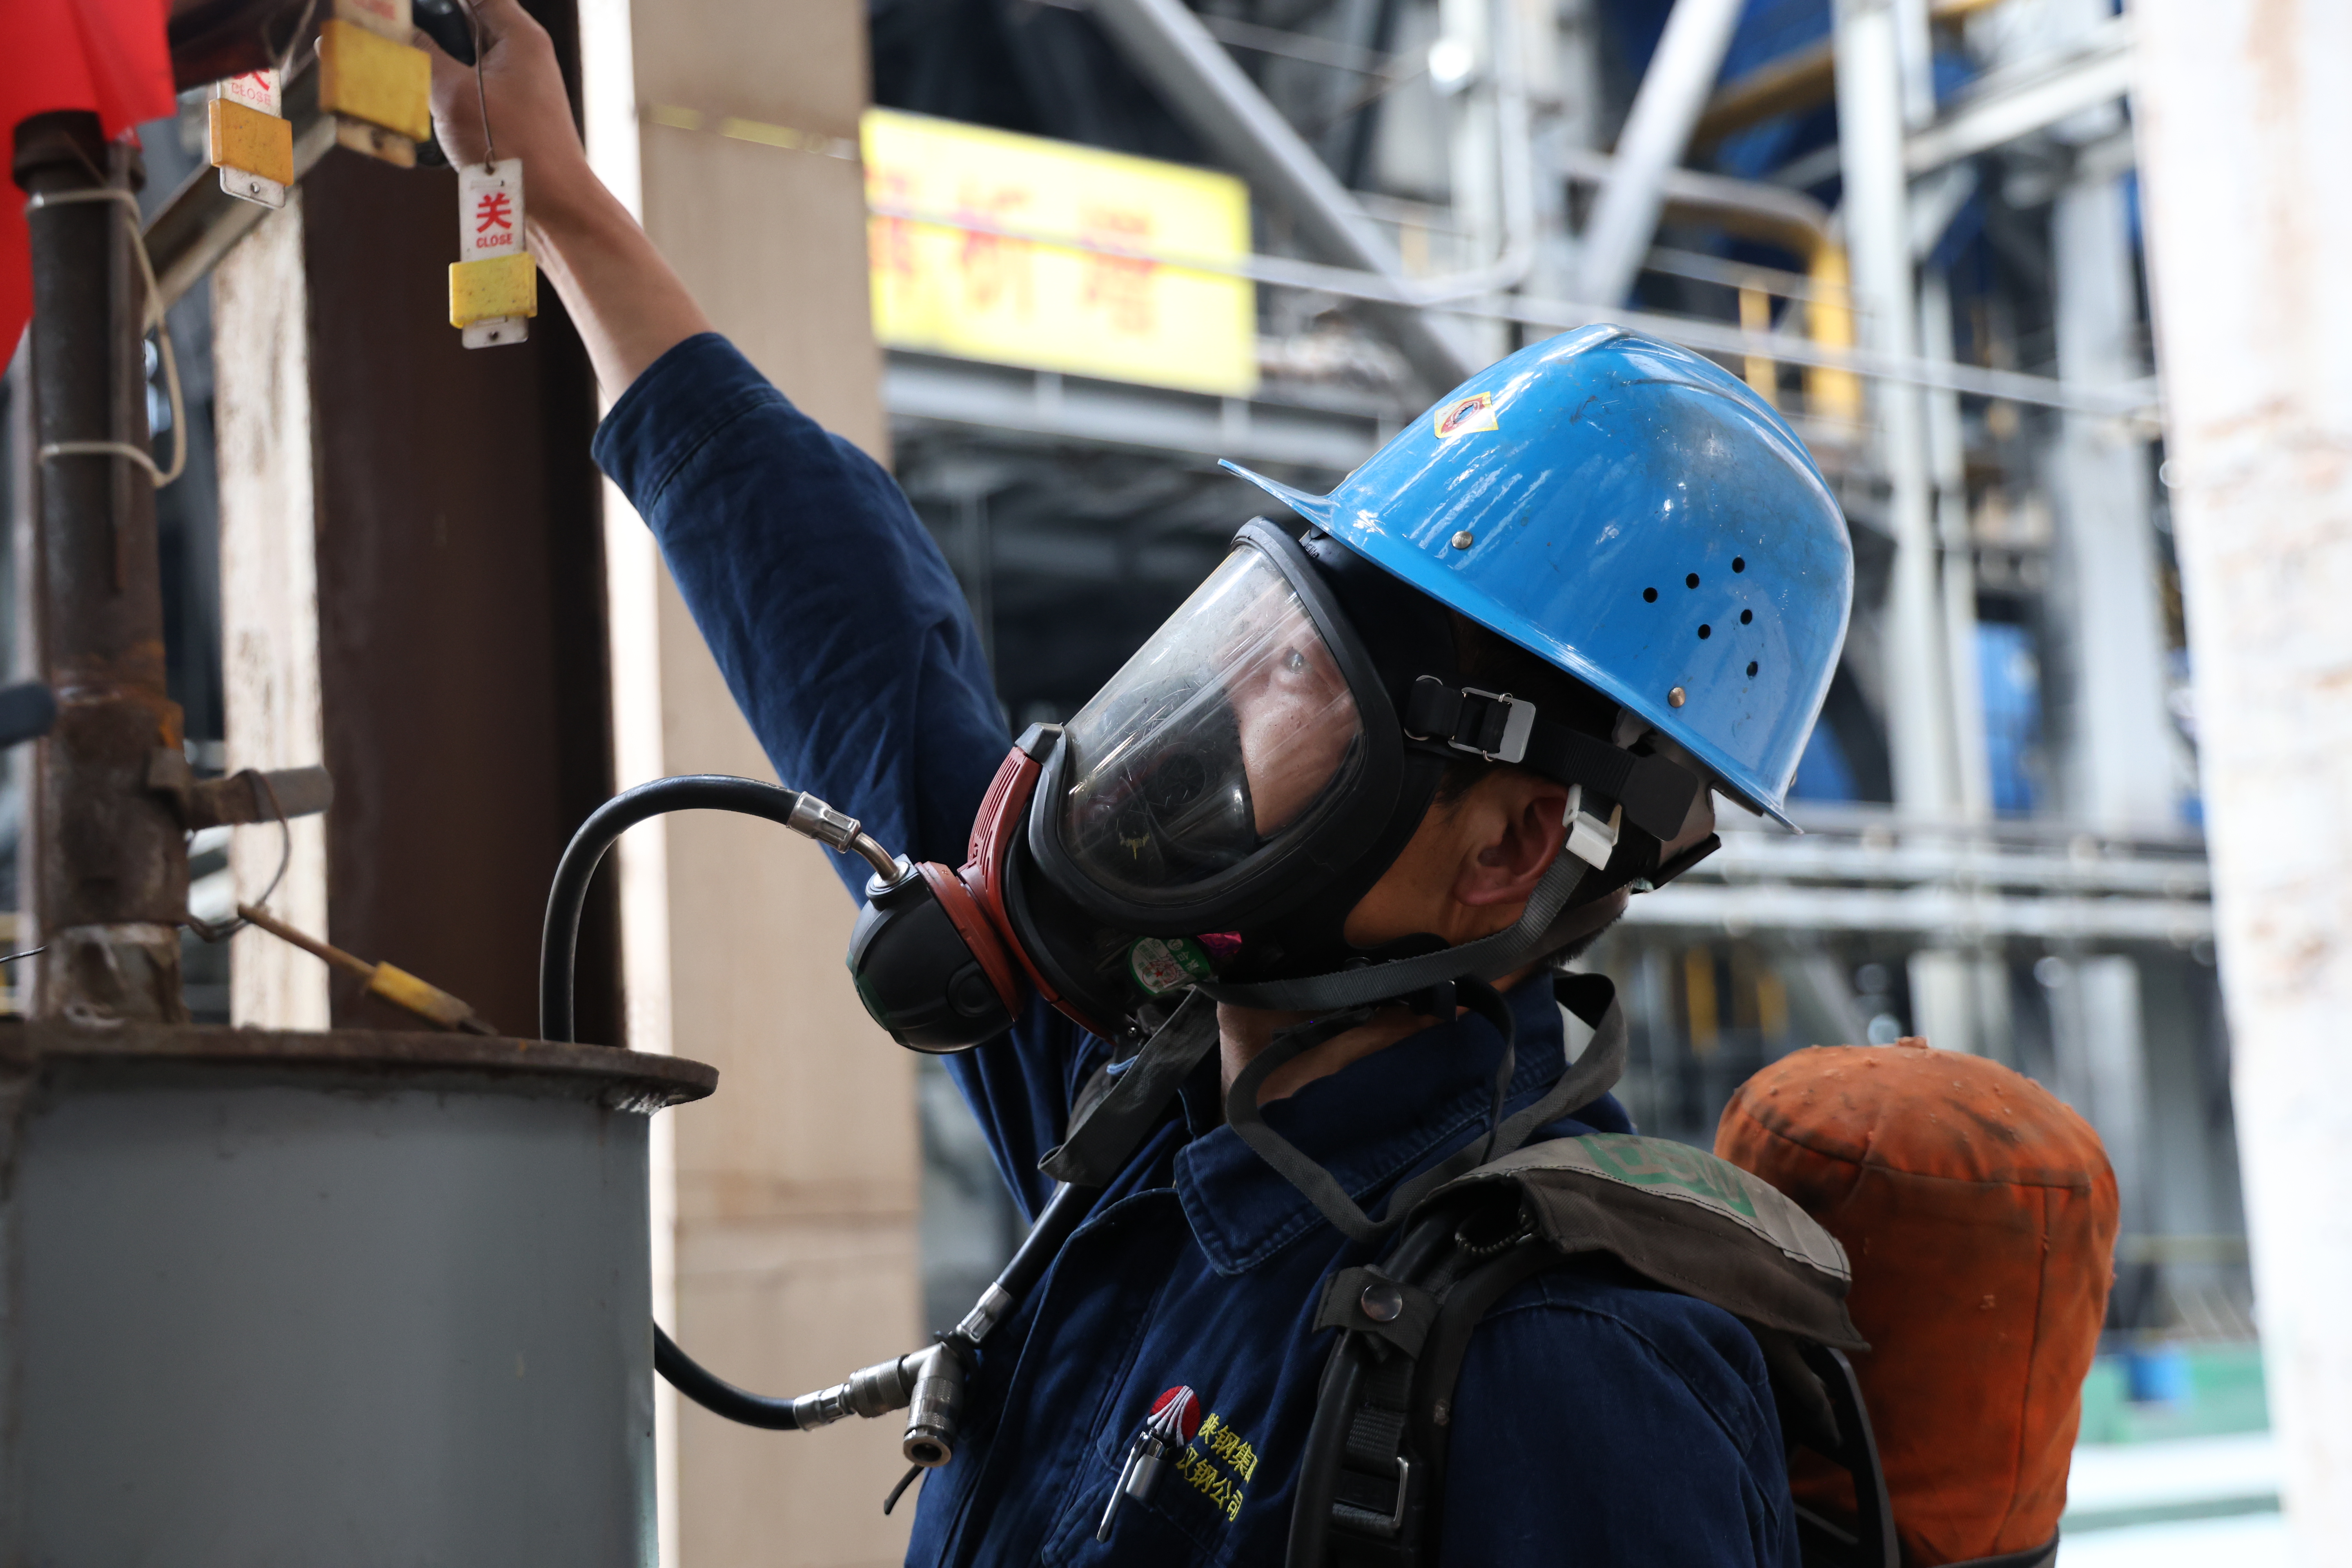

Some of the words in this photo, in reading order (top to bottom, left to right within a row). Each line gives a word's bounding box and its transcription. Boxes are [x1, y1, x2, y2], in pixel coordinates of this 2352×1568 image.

[232, 82, 272, 107] CLOSE
[476, 192, 512, 233] 关
[476, 233, 513, 249] CLOSE
